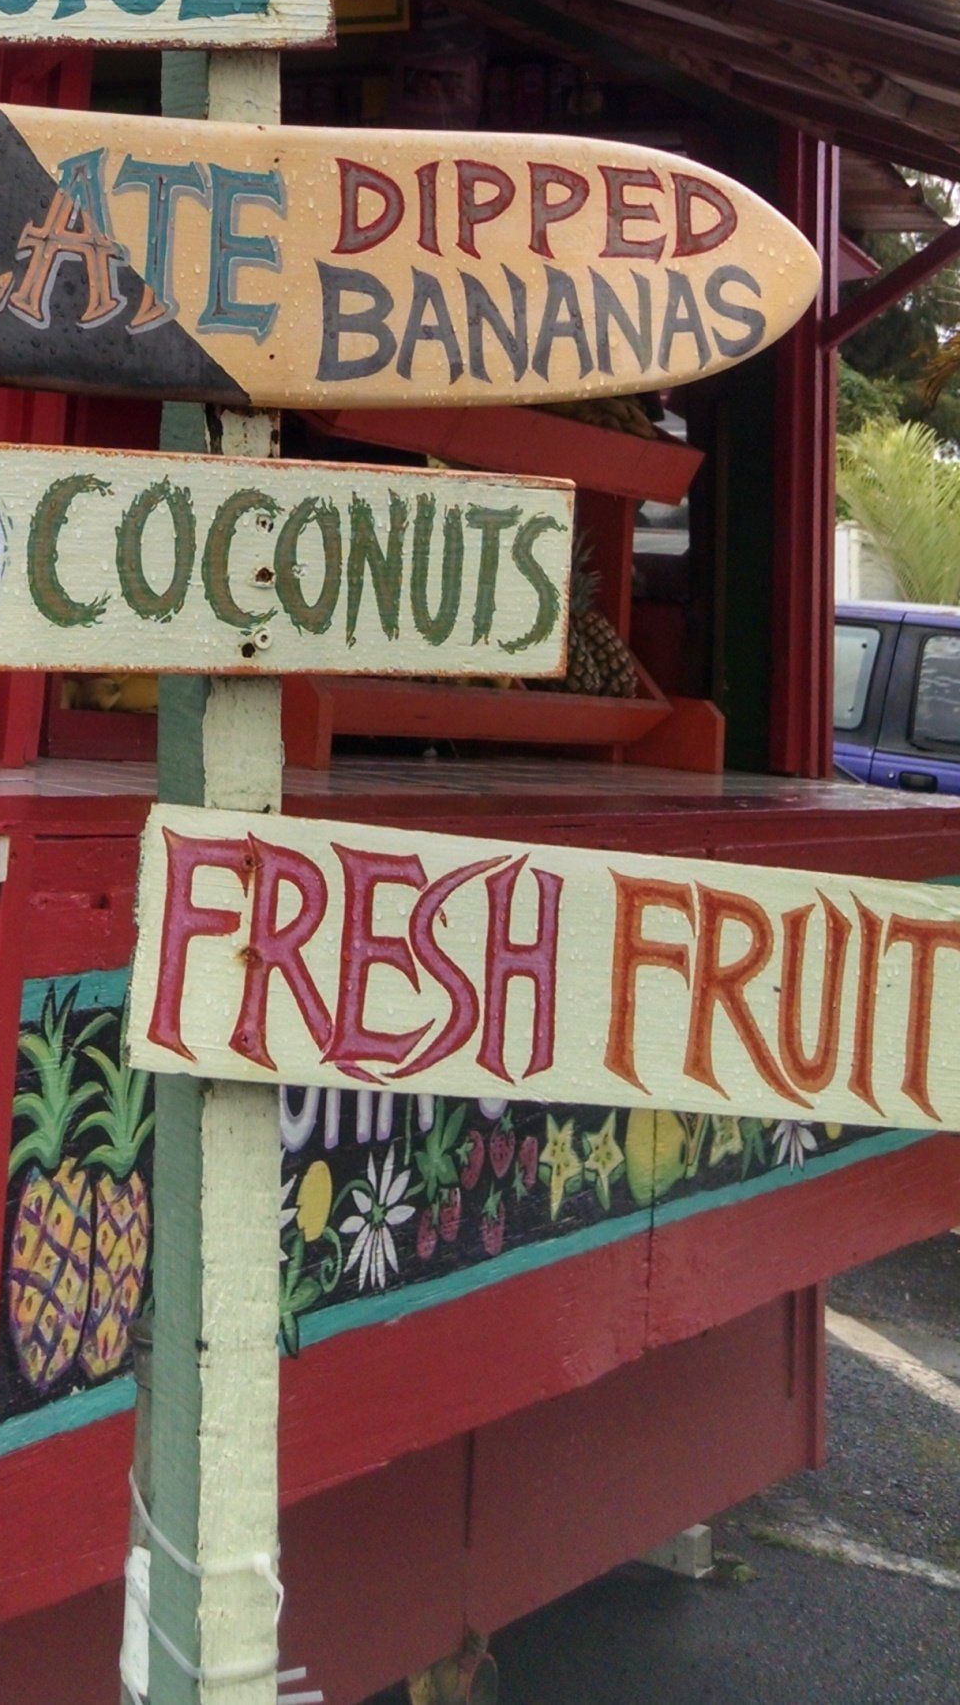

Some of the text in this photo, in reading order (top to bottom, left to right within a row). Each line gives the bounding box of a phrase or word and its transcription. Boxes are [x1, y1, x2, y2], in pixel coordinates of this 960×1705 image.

[331, 157, 738, 262] DIPPED
[314, 257, 767, 384] BANANAS
[27, 472, 568, 654] COCONUTS
[147, 826, 960, 1122] FRESH FRUIT
